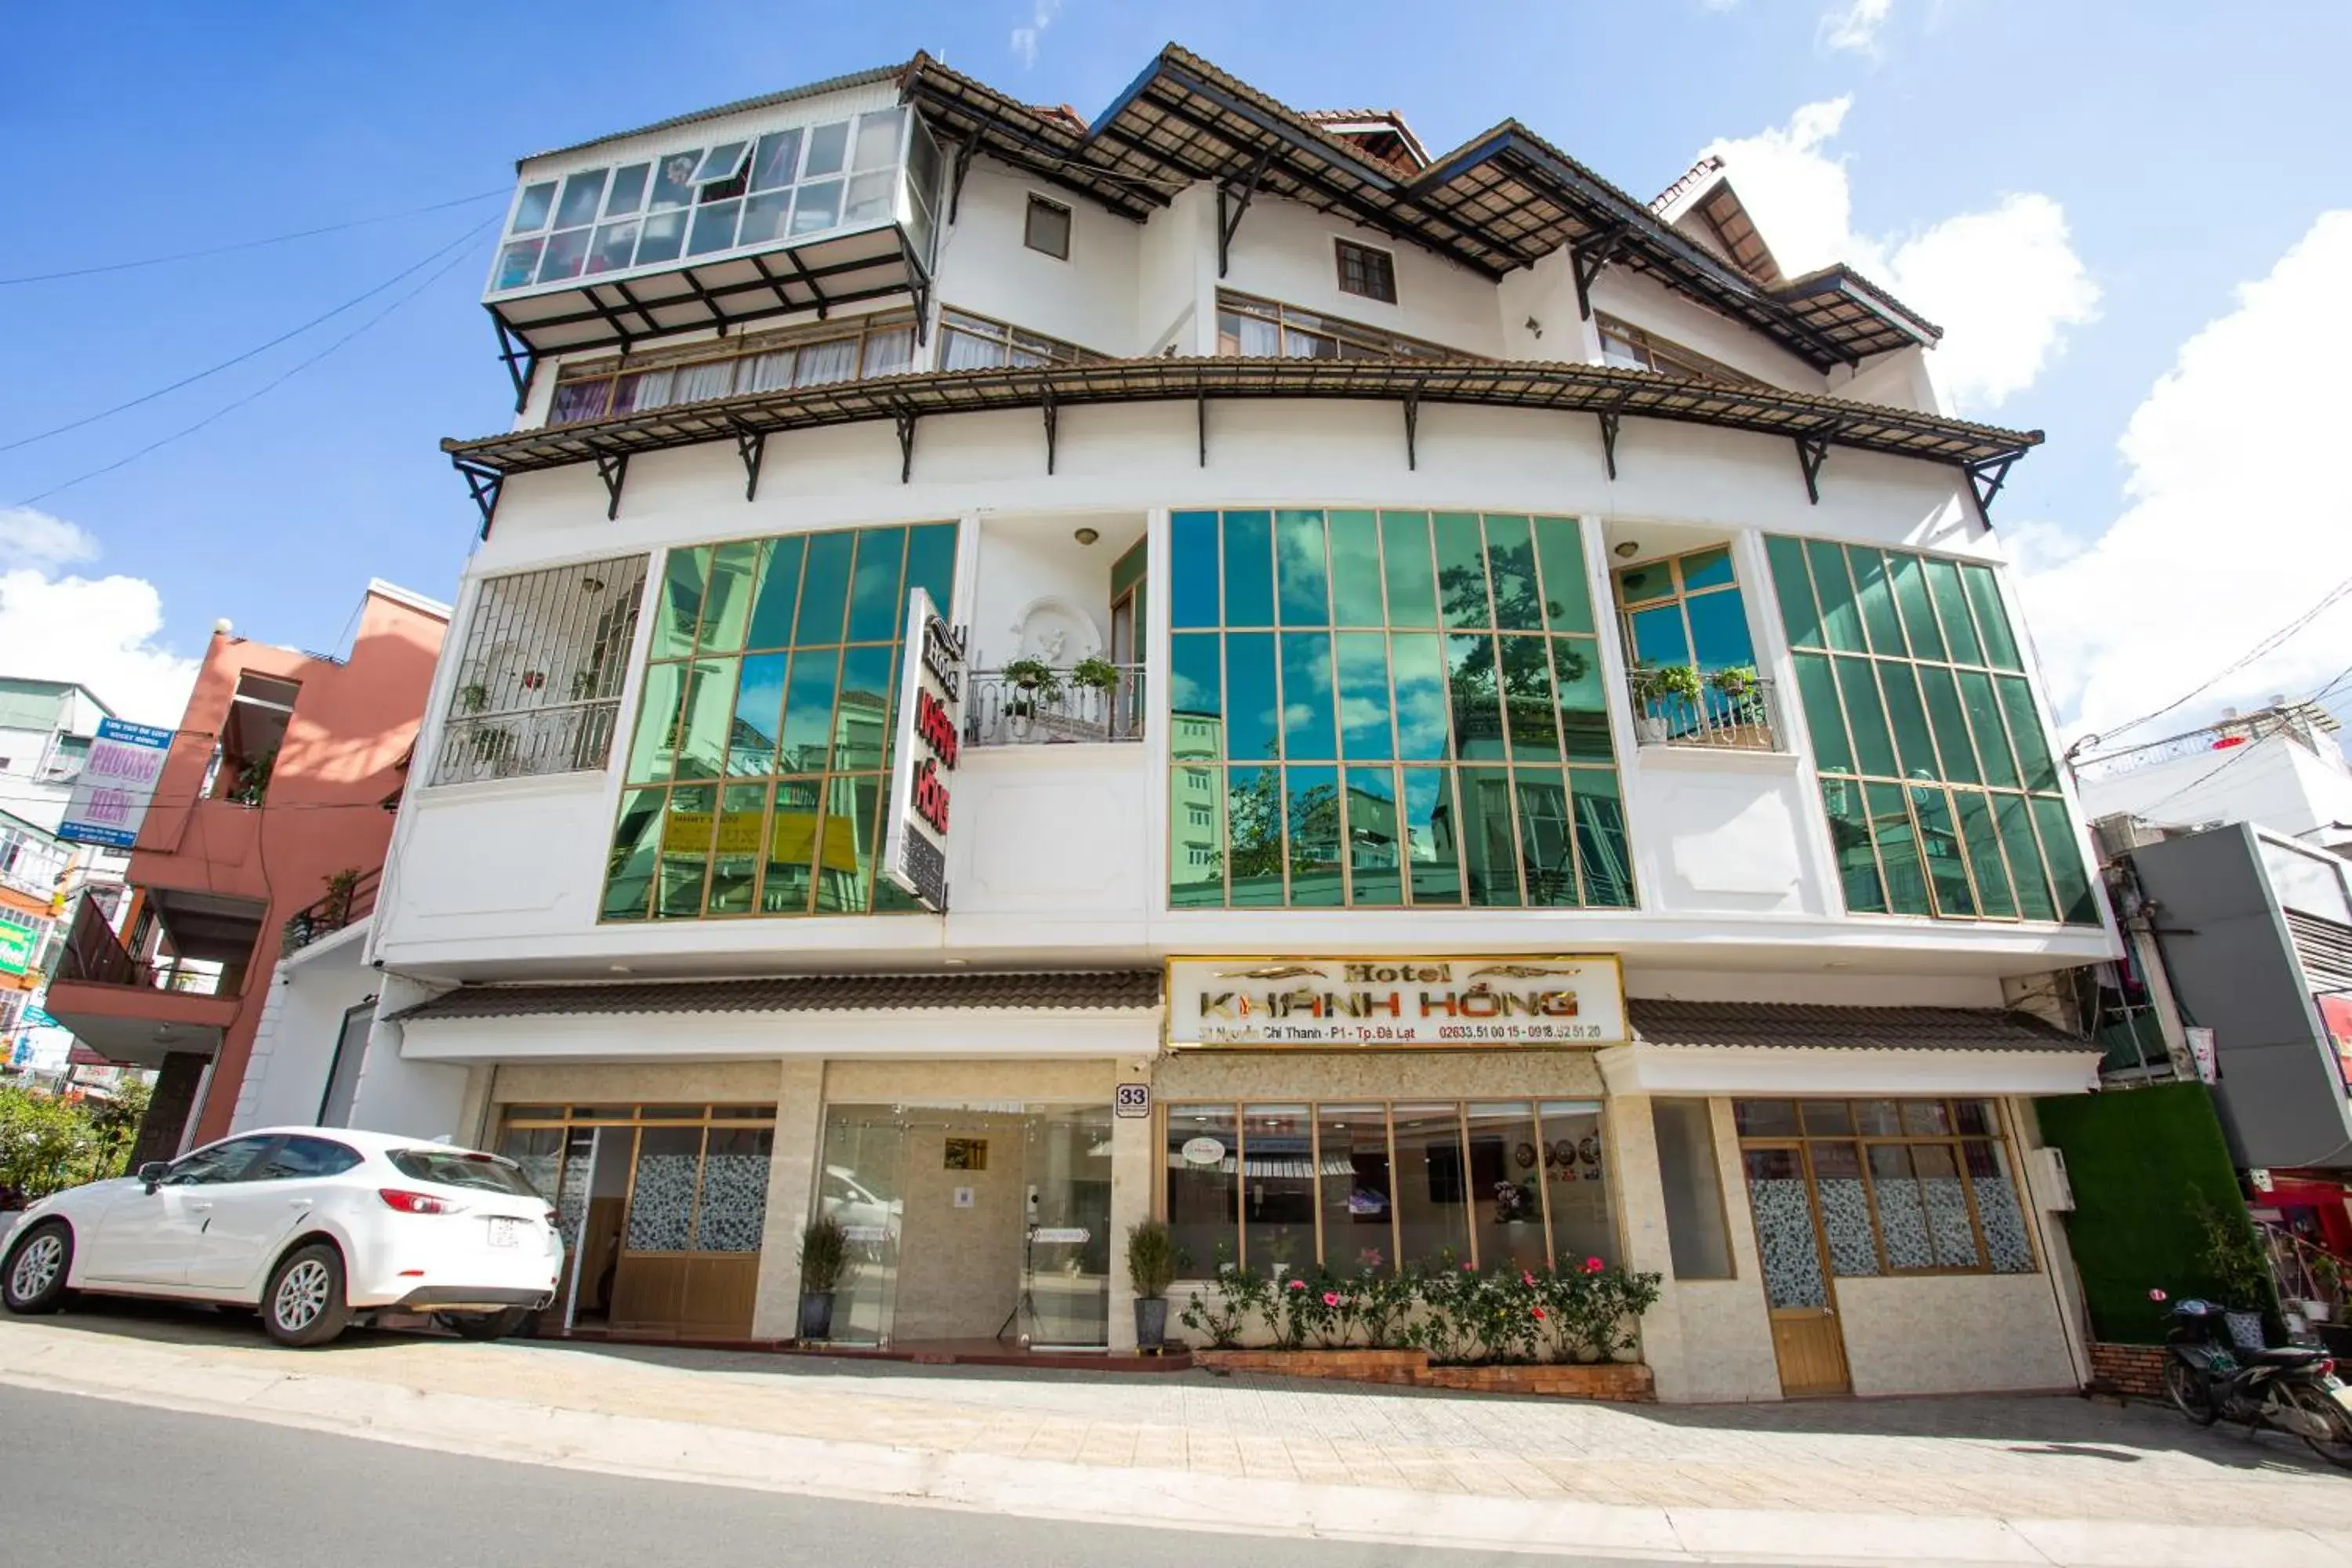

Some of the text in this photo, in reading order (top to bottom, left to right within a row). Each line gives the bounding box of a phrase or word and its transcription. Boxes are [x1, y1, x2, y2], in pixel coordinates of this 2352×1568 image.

[1343, 964, 1453, 982] Hotel
[1200, 986, 1400, 1018] KHÁNH
[1285, 1026, 1321, 1039] Thanh
[1330, 1026, 1345, 1039] P1
[1120, 1089, 1145, 1105] 33
